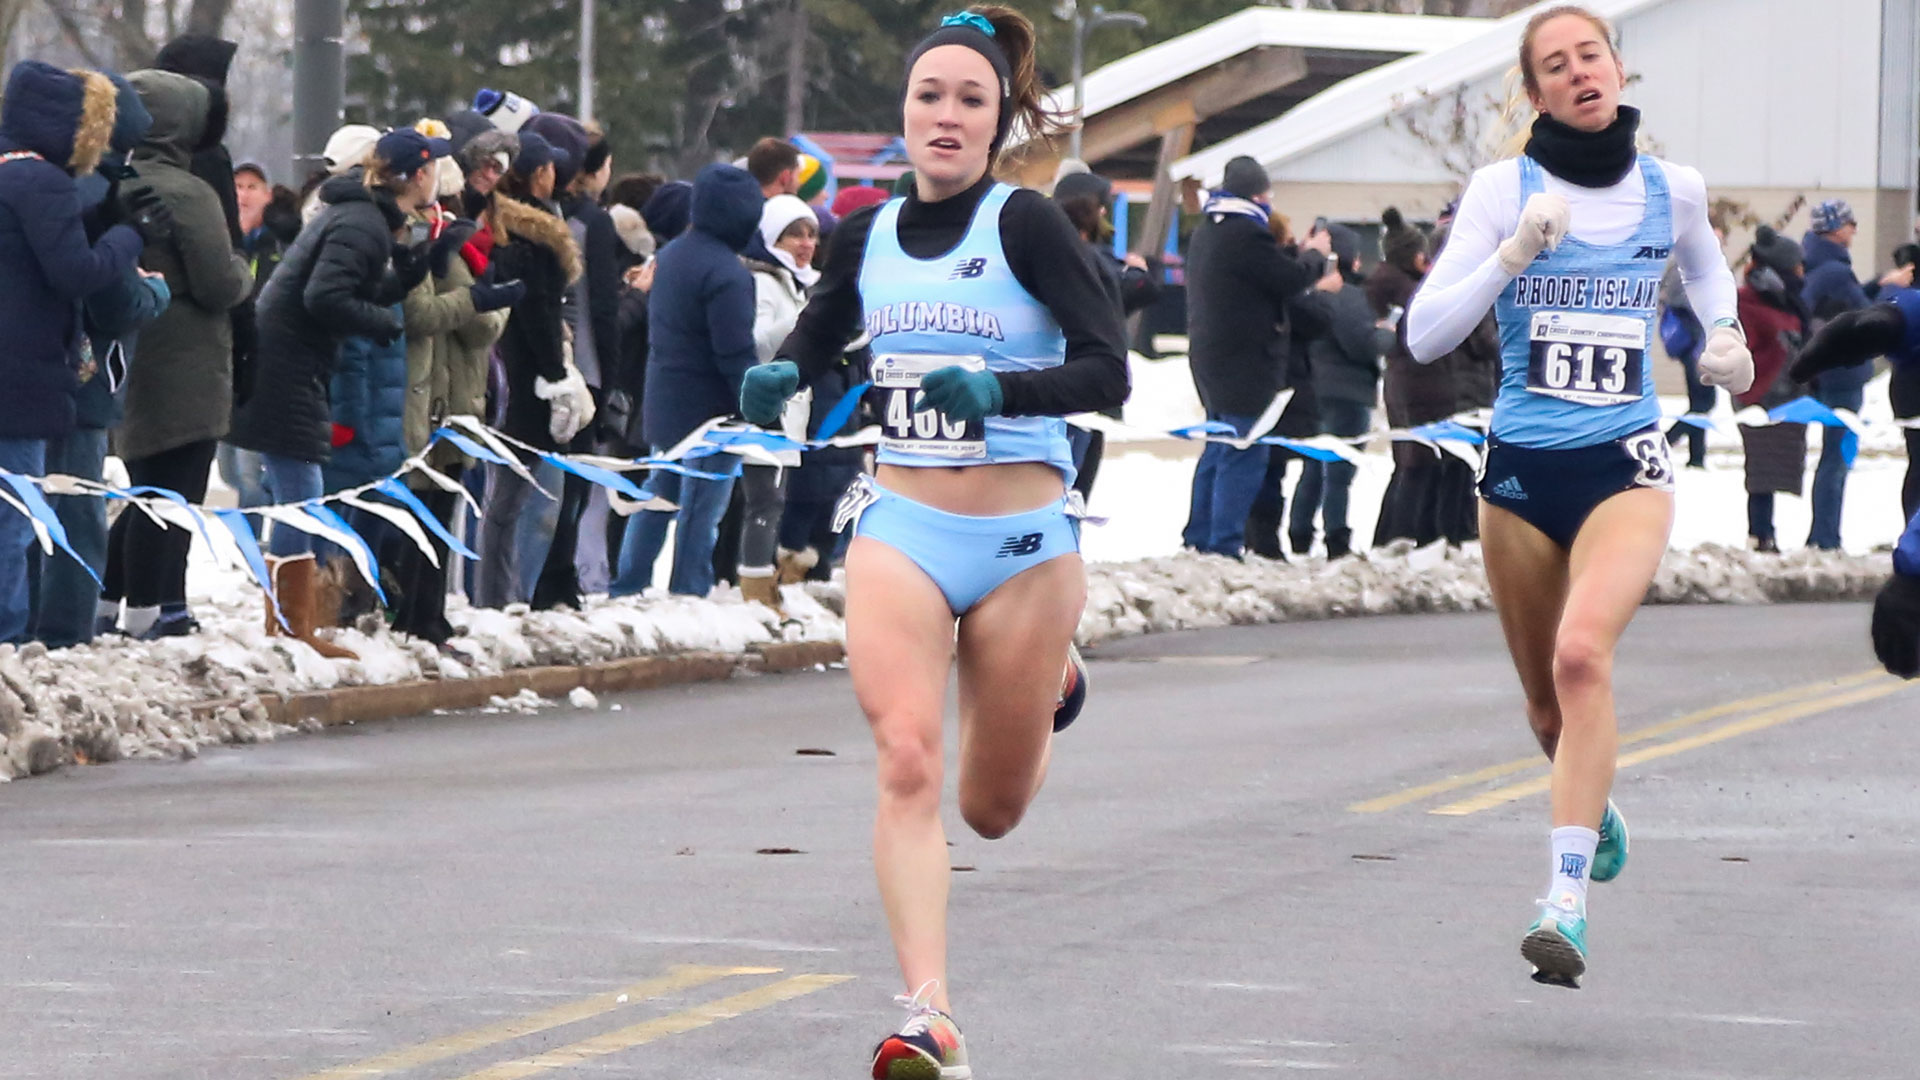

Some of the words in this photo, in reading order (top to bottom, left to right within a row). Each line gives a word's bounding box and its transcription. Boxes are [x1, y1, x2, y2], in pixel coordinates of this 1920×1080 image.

[1515, 275, 1588, 308] RHODE
[1592, 277, 1662, 311] ISLAN
[1545, 343, 1627, 393] 613
[1494, 487, 1529, 500] adidas
